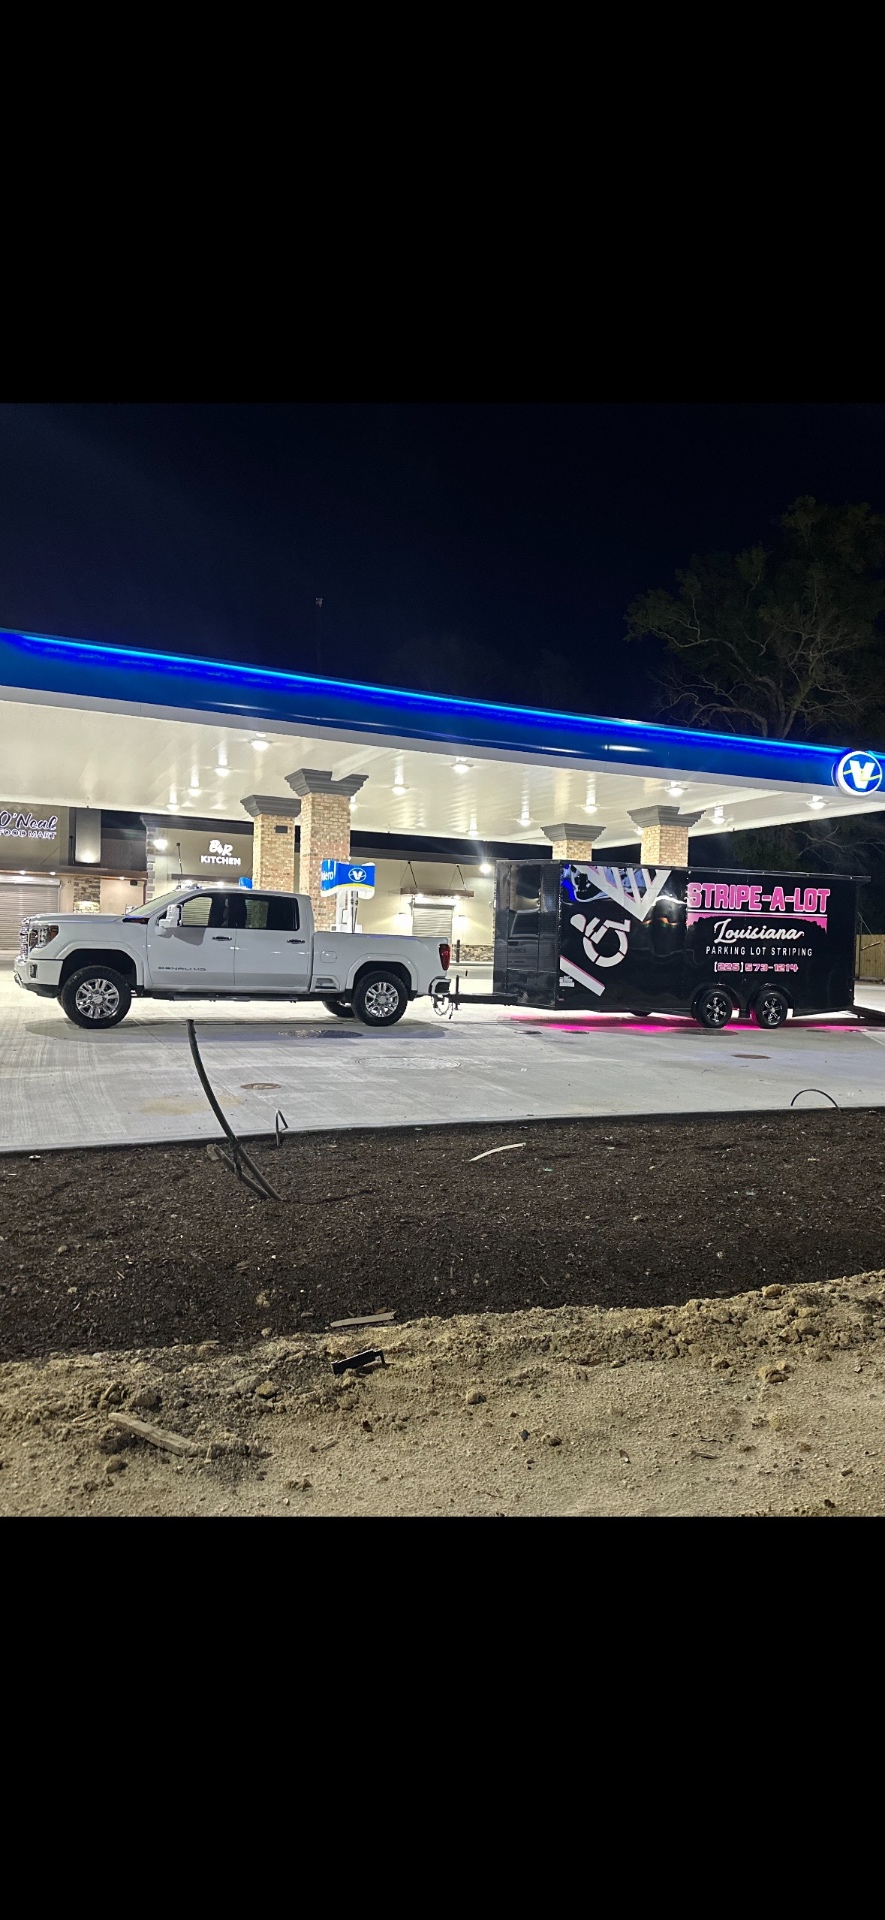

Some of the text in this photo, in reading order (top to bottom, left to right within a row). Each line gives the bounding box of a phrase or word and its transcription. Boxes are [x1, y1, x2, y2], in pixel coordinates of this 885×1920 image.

[0, 810, 58, 830] O'Neal
[27, 830, 57, 840] MART
[200, 855, 241, 866] KITCHEN
[687, 882, 831, 913] STRIPE-A-LOT
[713, 918, 805, 944] Louisiana
[705, 945, 813, 957] PARKING LOT STRIPING
[744, 962, 799, 973] 573-1214
